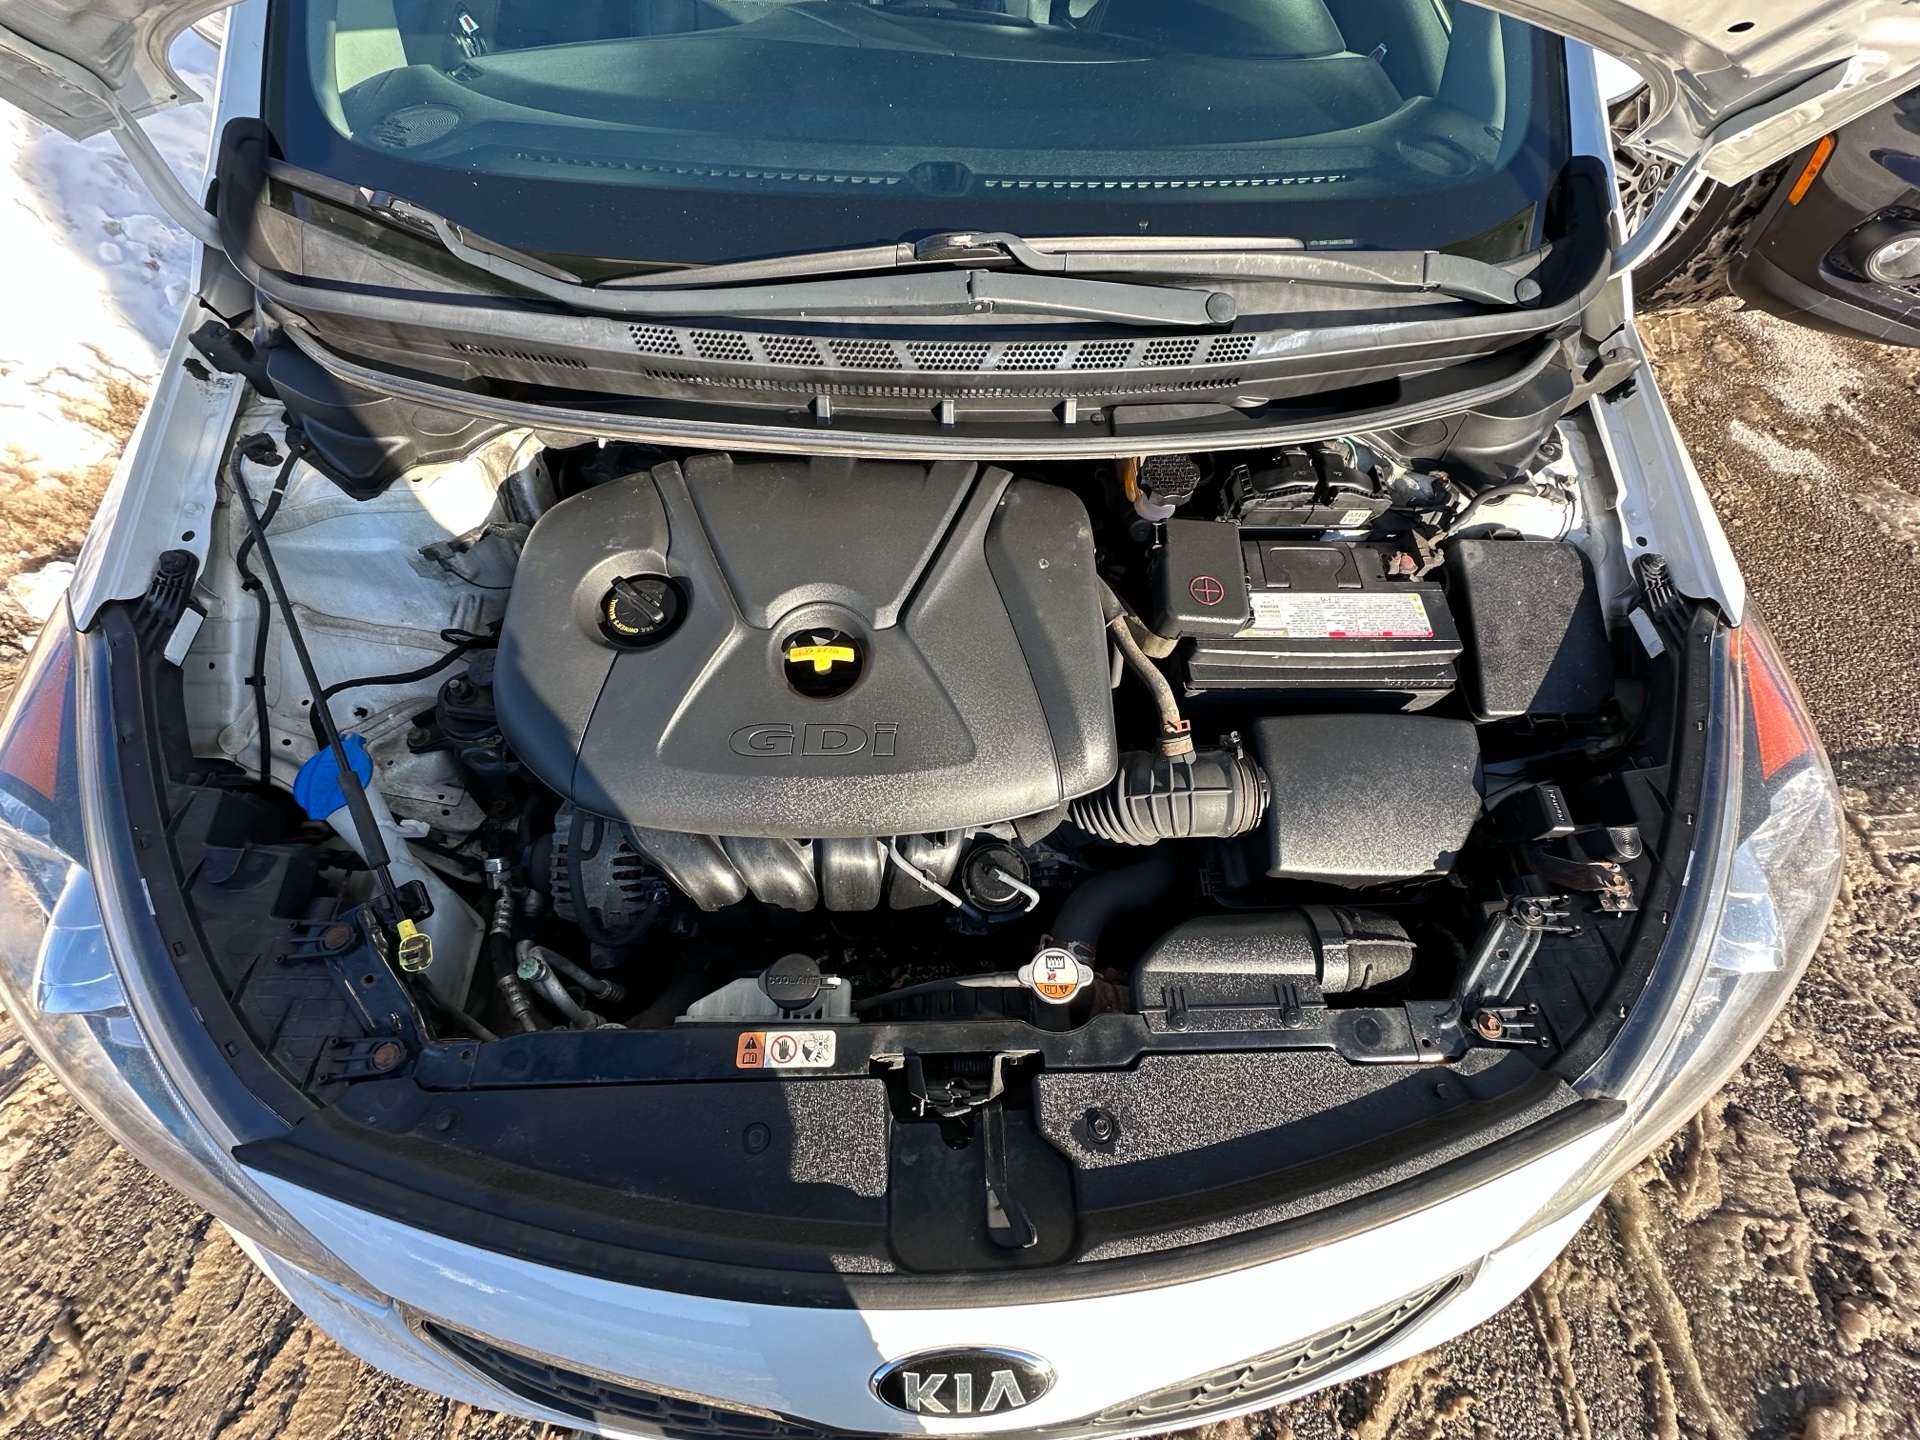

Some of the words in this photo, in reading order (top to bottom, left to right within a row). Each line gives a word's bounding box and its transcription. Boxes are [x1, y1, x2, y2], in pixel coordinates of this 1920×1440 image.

[728, 721, 899, 757] GDi
[768, 974, 819, 986] COOLANT
[902, 1369, 1027, 1413] KIA
